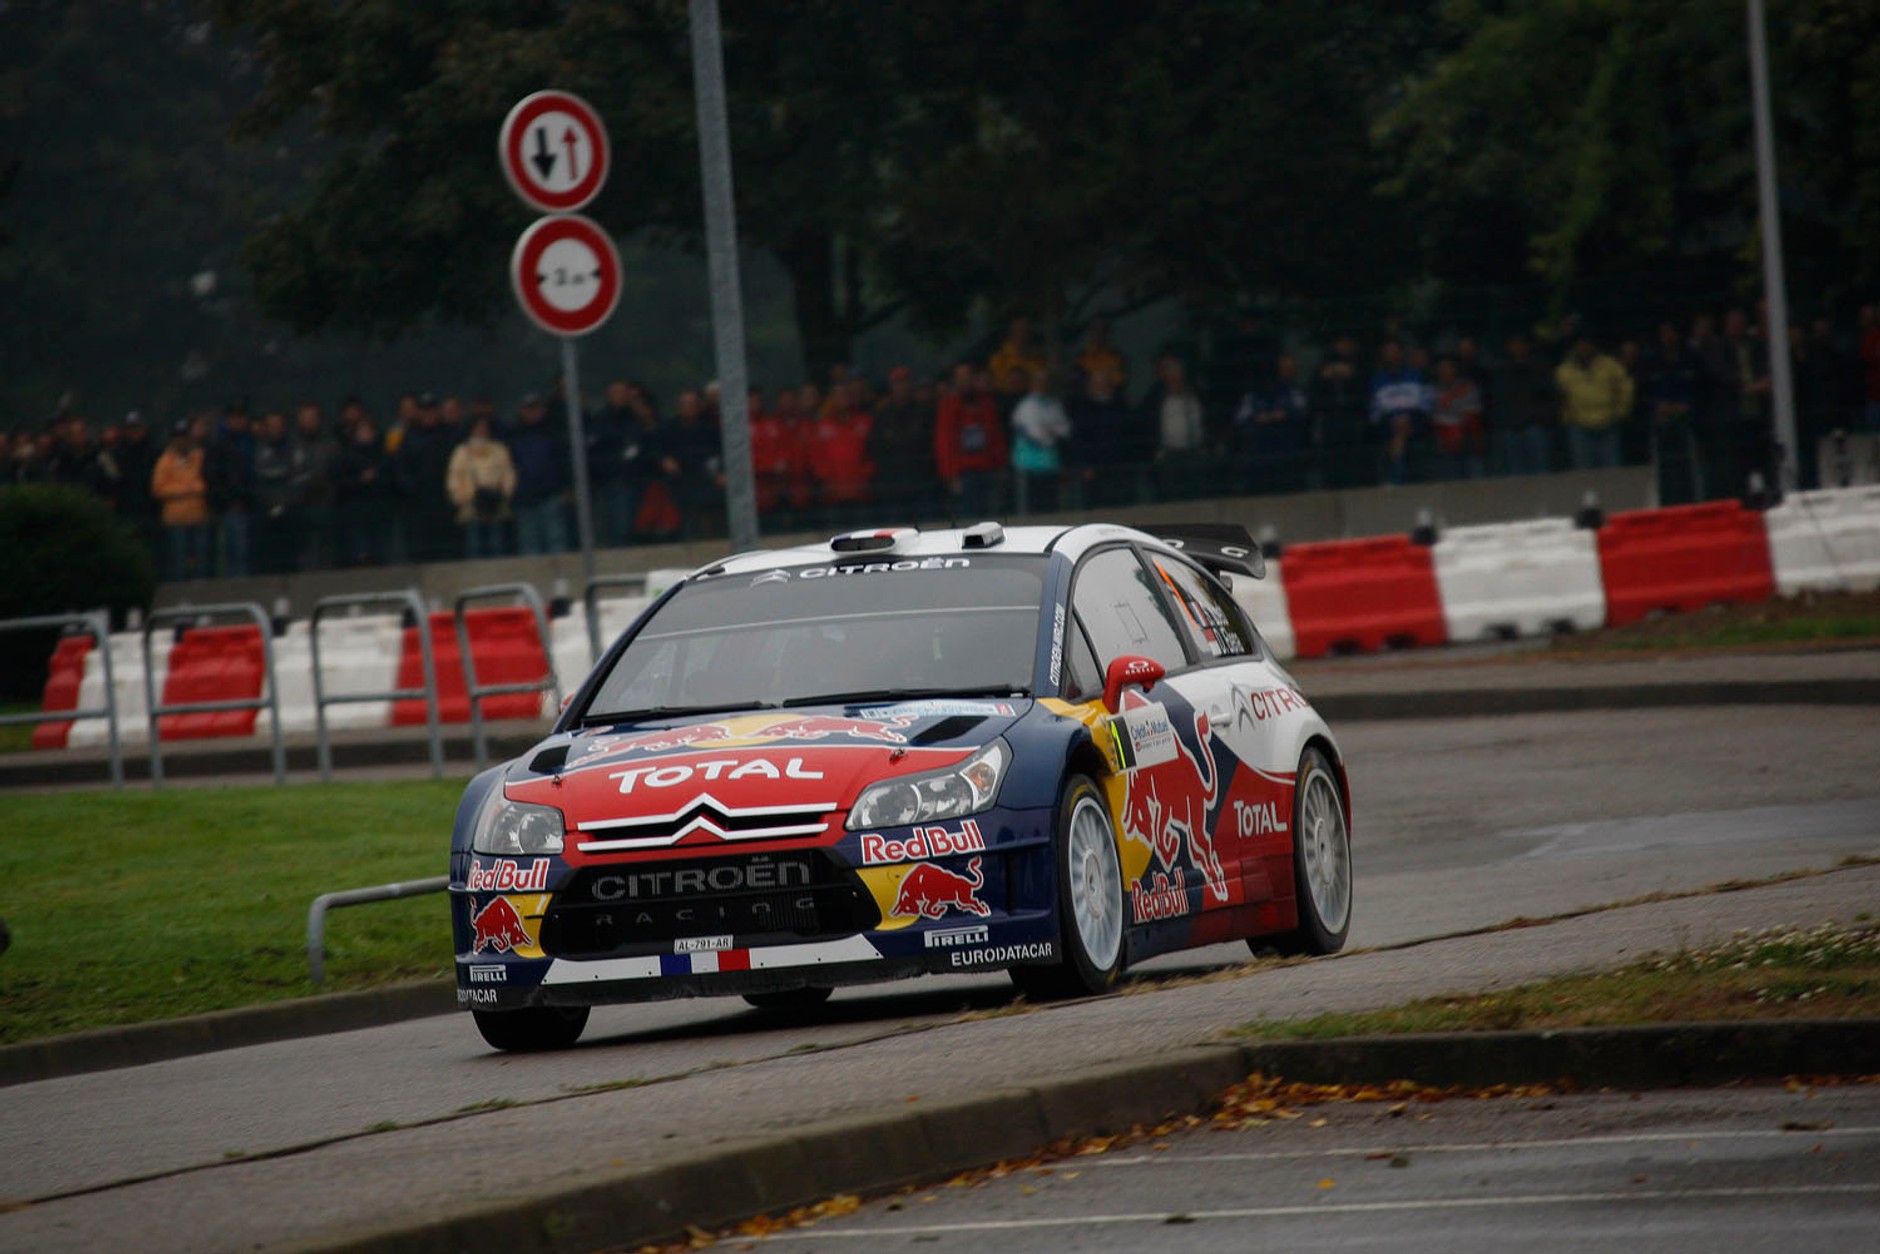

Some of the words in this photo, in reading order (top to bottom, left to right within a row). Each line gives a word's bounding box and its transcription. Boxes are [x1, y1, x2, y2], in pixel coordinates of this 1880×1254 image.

[608, 758, 824, 794] TOTAL
[1233, 800, 1288, 839] TOTAL
[860, 826, 929, 865] Red
[925, 819, 986, 857] Bull
[466, 858, 502, 891] Red
[497, 858, 551, 891] Bull
[1131, 870, 1163, 924] Red
[1158, 866, 1189, 919] Bull
[678, 937, 729, 950] AL-791-AR
[924, 925, 989, 948] PIRELLI
[951, 942, 1053, 967] EURODATACAR
[469, 965, 507, 982] PIRELLI
